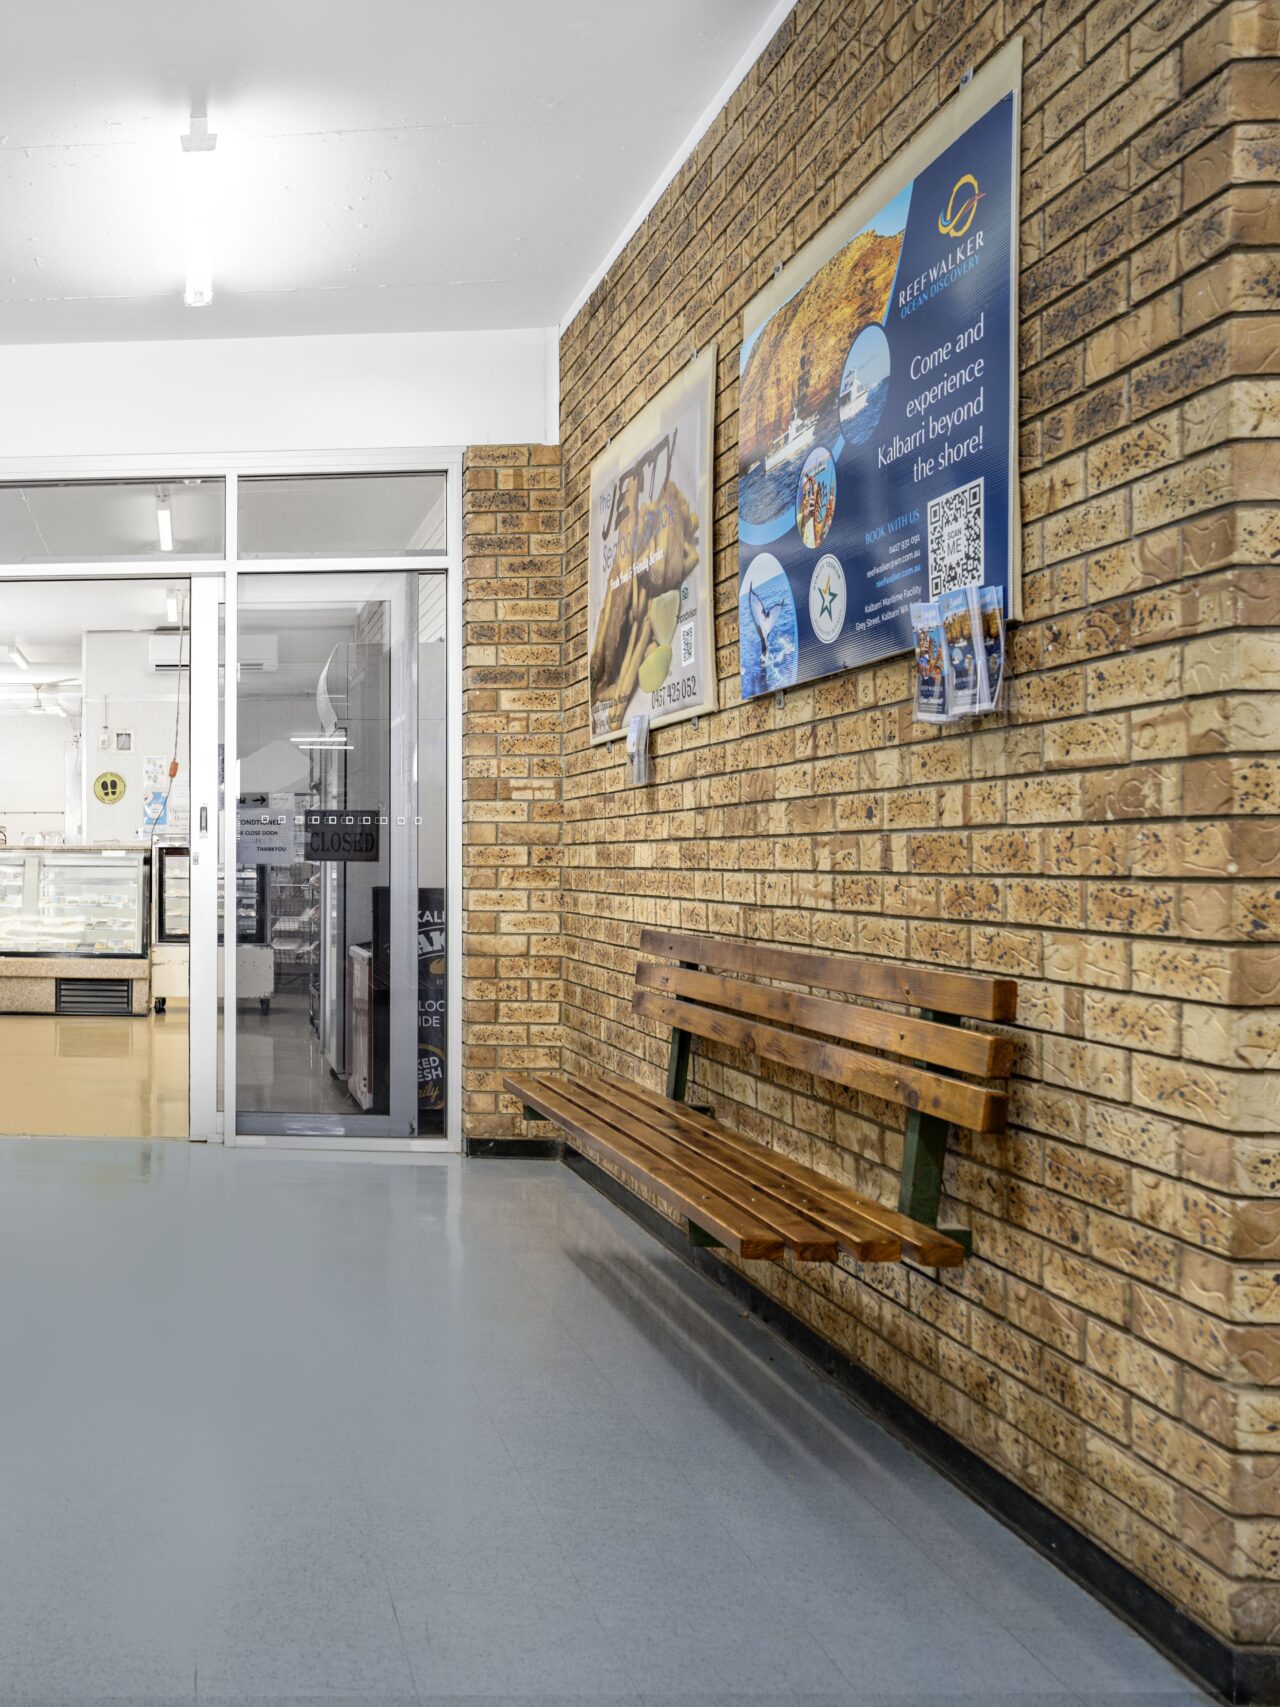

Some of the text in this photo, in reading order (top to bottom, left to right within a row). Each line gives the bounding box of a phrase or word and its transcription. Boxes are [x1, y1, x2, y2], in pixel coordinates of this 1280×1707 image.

[899, 231, 984, 308] REEFWALKER
[901, 253, 982, 319] OCEAN DISCOVERY
[910, 312, 984, 380] Come and
[906, 358, 984, 417] experience
[878, 386, 984, 468] Kalbarri beyond
[913, 425, 983, 482] the shore!
[602, 427, 678, 541] JETTY
[865, 508, 920, 545] BOOK WITH US
[947, 528, 961, 540] SCAN
[947, 538, 961, 556] ME
[904, 585, 922, 599] Facility
[681, 675, 697, 699] 052
[310, 832, 375, 853] CLOSED
[418, 1000, 446, 1011] LOC
